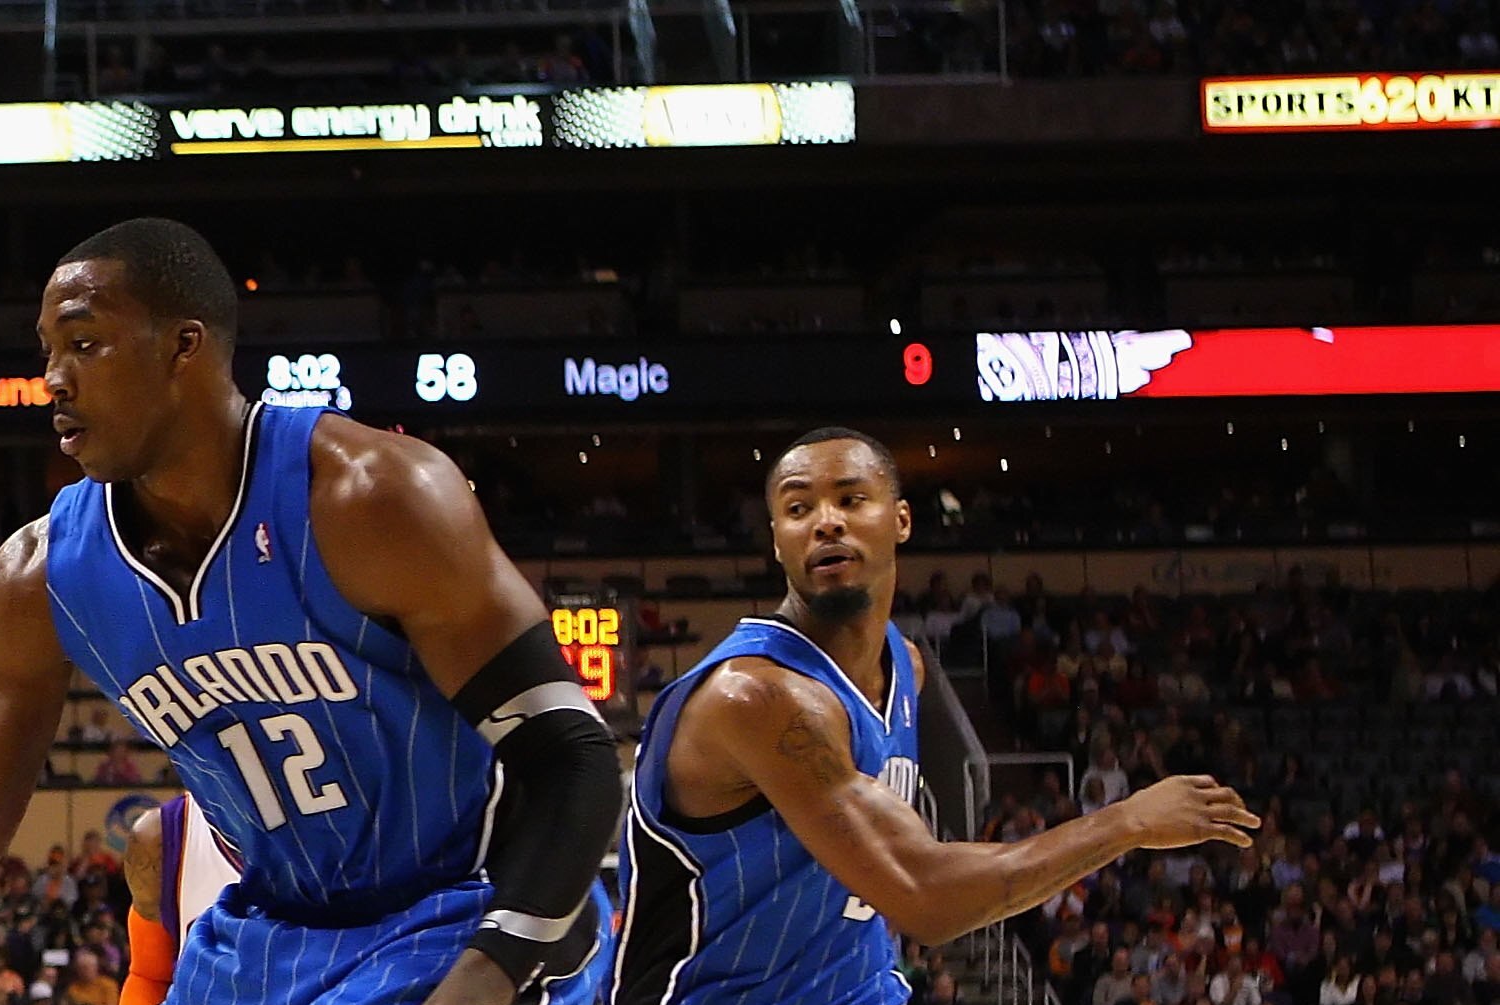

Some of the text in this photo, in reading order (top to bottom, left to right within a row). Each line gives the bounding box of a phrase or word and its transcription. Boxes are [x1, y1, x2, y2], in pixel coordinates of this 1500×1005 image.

[169, 94, 542, 142] verve energy drink
[1211, 86, 1356, 119] SPORTS
[1361, 74, 1447, 125] 620
[266, 353, 341, 391] 8:02
[415, 352, 478, 402] 58
[563, 356, 670, 402] Magic
[903, 342, 933, 385] 9
[551, 608, 620, 646] 8:02
[119, 642, 360, 748] RLANDO
[216, 712, 349, 832] 12
